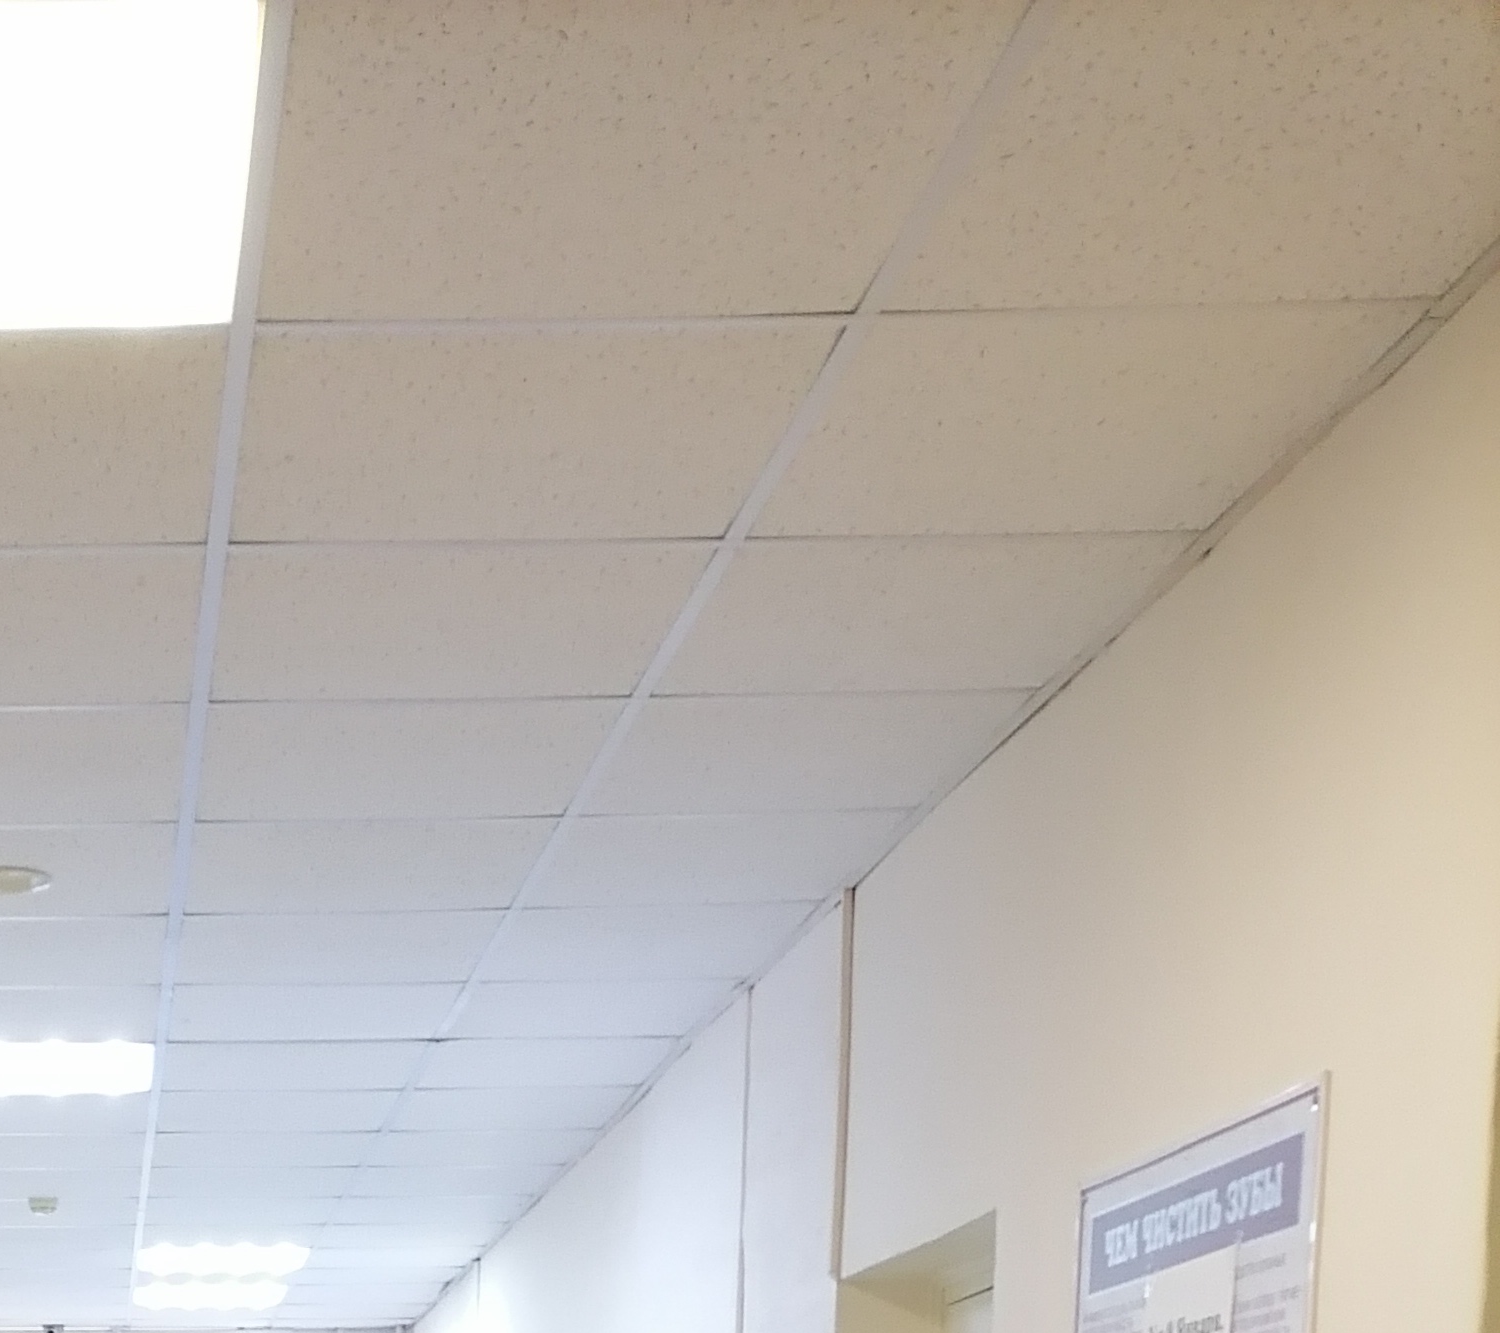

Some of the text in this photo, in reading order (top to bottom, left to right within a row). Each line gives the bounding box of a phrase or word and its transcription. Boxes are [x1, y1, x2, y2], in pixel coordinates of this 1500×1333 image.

[1104, 1161, 1285, 1268] ЧЕМ ЧИСТИТЬ ЗУБЫ
